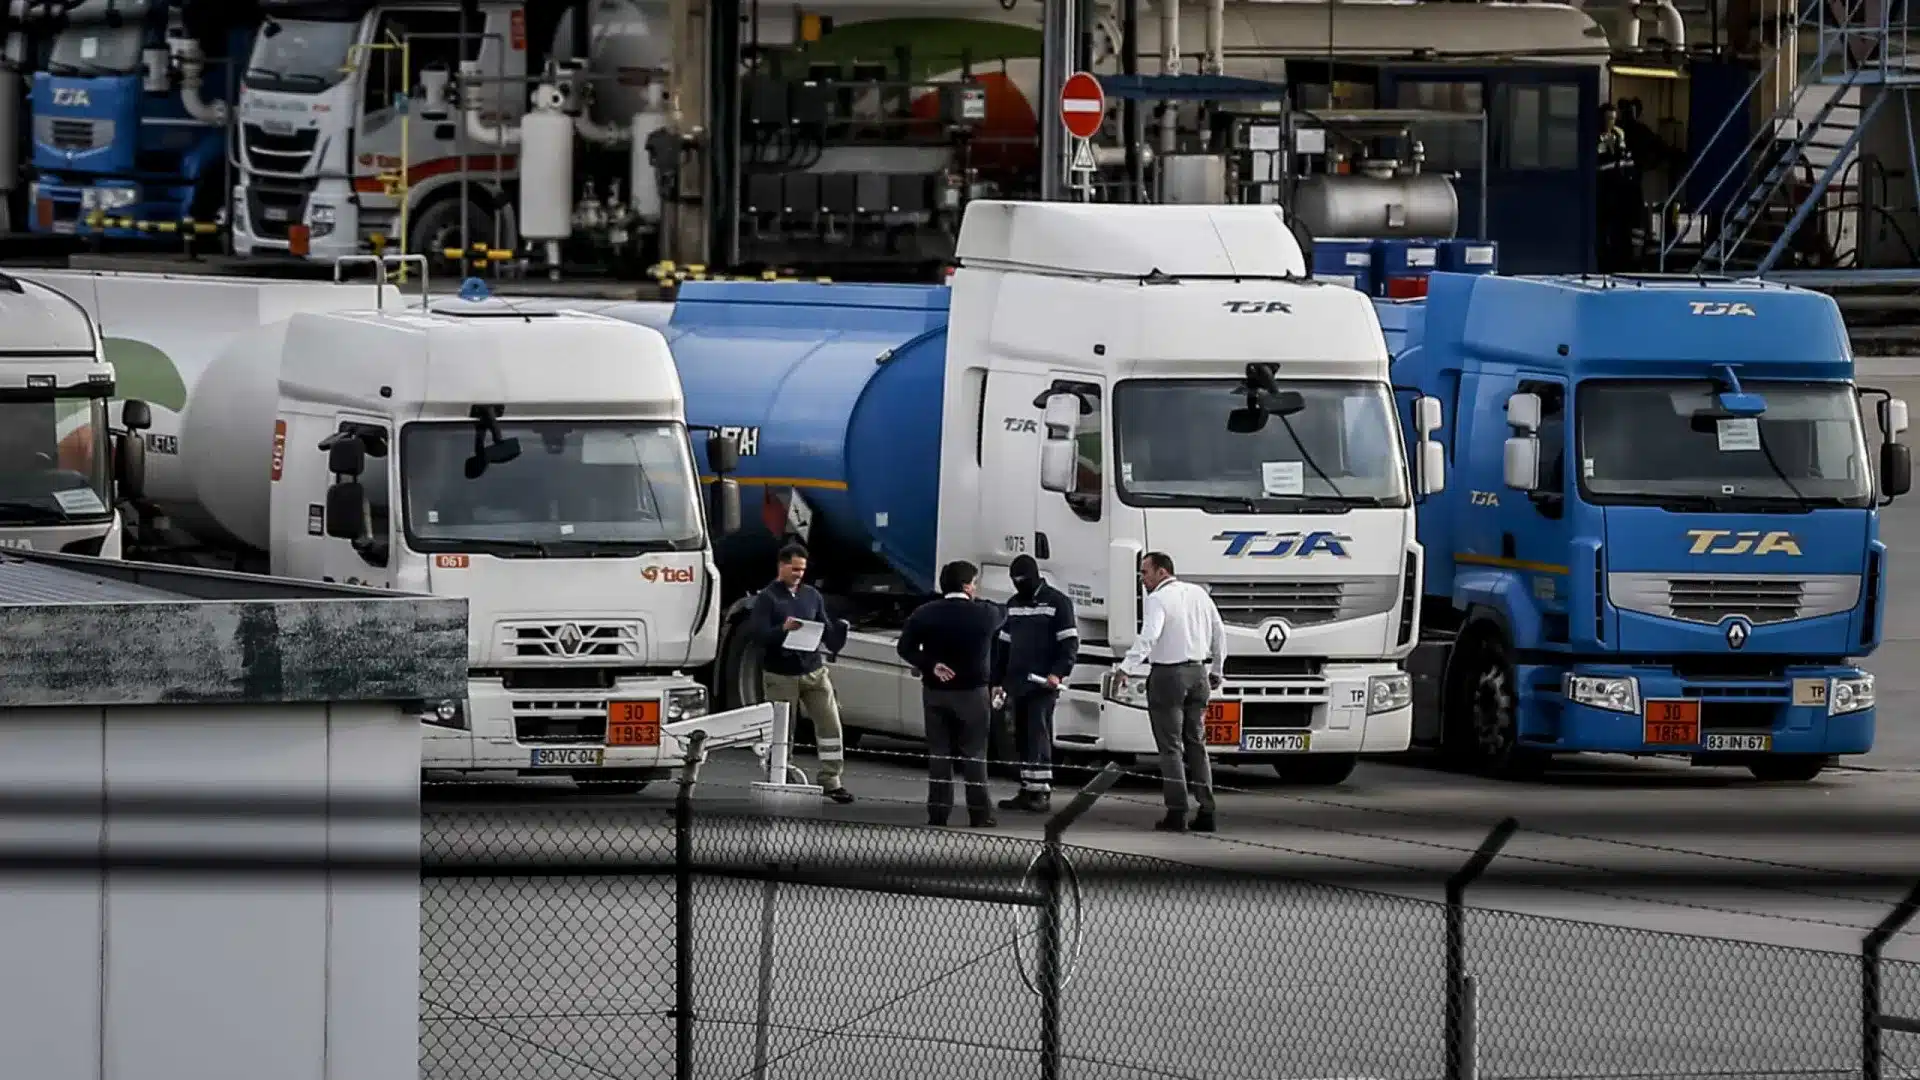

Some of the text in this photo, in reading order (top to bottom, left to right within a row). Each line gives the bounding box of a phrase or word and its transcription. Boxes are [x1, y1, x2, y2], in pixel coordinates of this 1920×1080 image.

[1222, 301, 1291, 313] TJA
[1690, 302, 1756, 316] TJA
[1004, 417, 1037, 433] TJA
[1471, 490, 1499, 506] TJA
[1005, 535, 1026, 552] 1075
[1211, 530, 1353, 559] TJA
[1687, 530, 1803, 555] TJA
[661, 566, 694, 582] tiel
[1350, 690, 1365, 702] TP
[1811, 686, 1825, 697] TP
[624, 704, 644, 720] 30
[1664, 704, 1681, 720] 30
[1204, 726, 1233, 742] 863
